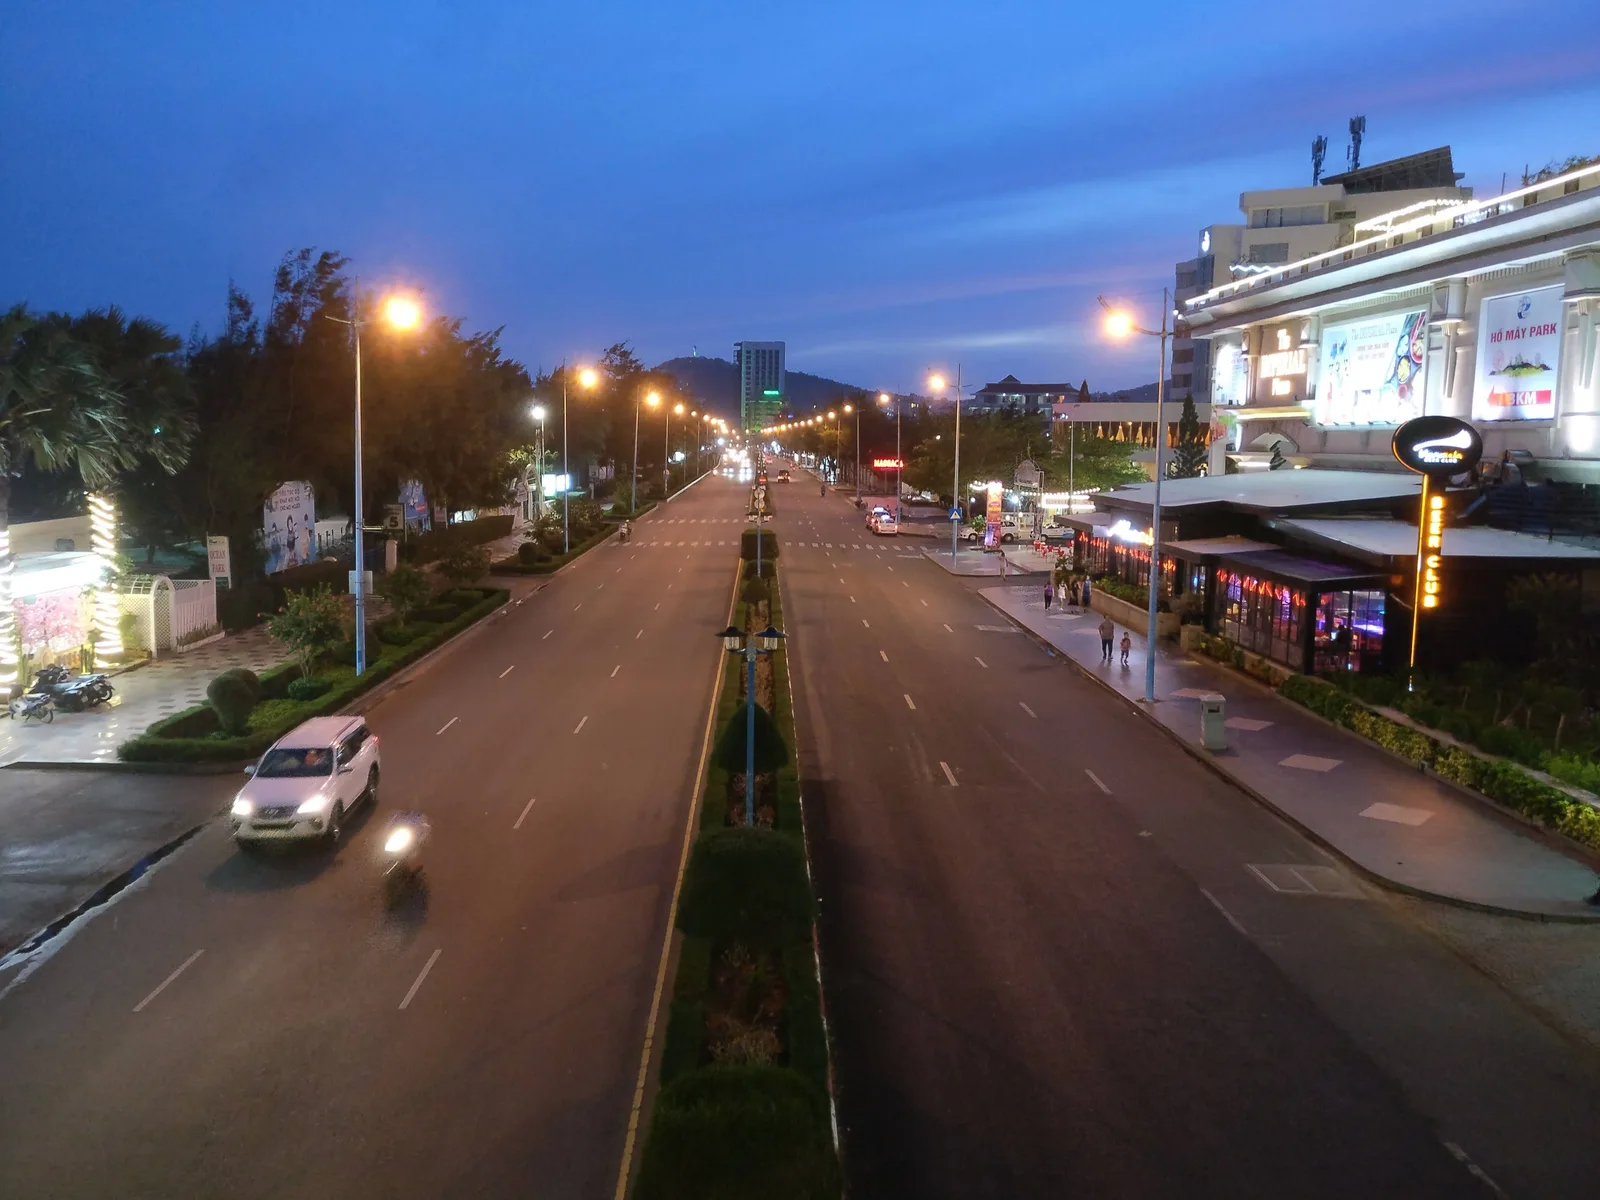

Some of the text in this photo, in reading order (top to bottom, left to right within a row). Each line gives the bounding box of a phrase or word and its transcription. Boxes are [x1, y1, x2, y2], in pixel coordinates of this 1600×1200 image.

[1529, 322, 1558, 338] PARK
[389, 516, 399, 528] 5
[1428, 495, 1444, 549] BEER
[211, 563, 226, 573] PARK
[1424, 555, 1441, 608] CLUB
